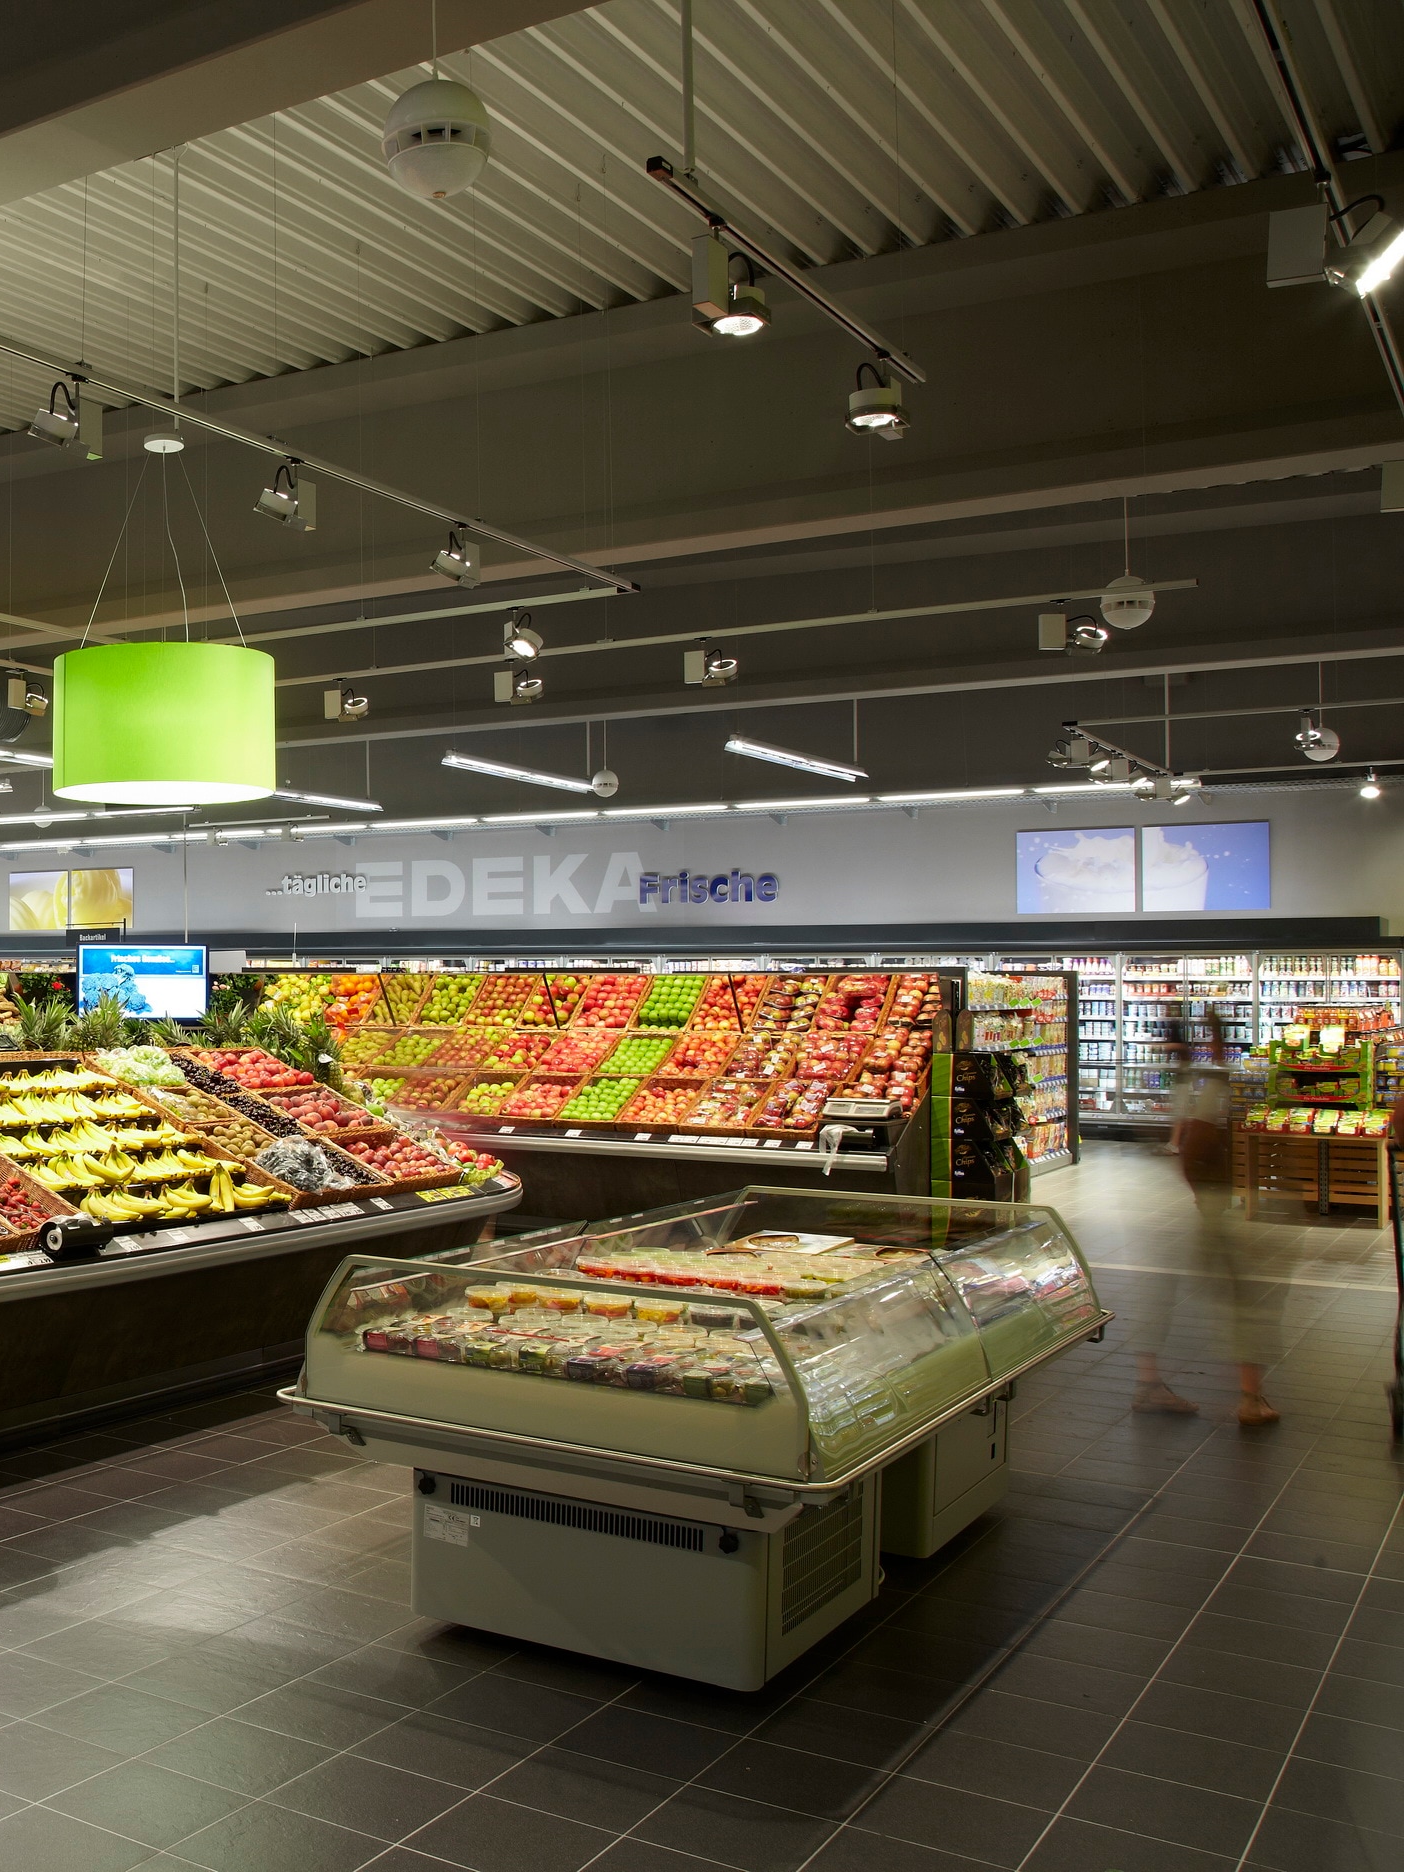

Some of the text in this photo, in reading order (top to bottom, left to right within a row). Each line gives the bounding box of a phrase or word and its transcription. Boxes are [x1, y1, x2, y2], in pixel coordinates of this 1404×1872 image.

[355, 851, 658, 918] EDEKA
[639, 869, 780, 905] Frische
[79, 933, 107, 941] Backartikel
